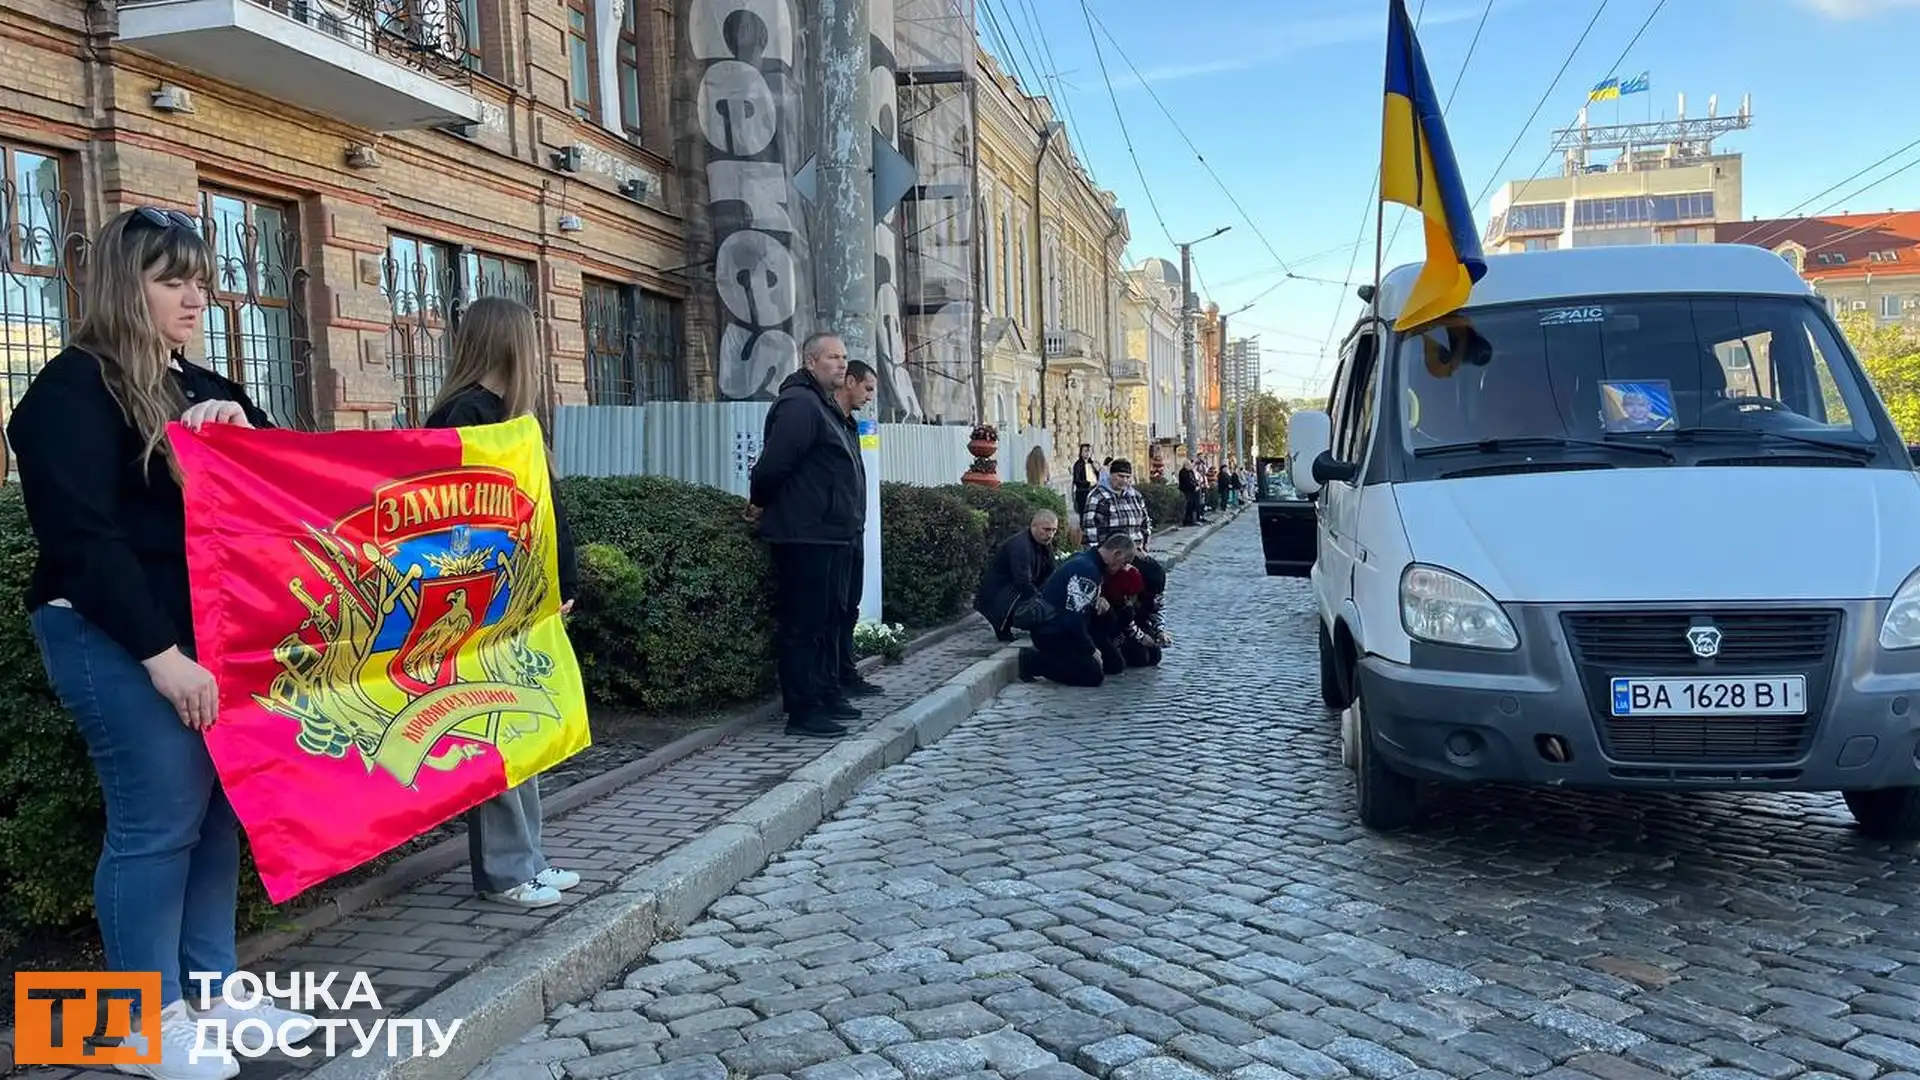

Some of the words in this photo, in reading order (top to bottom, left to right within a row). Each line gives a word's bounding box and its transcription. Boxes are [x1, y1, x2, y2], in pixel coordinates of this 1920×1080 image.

[380, 482, 514, 533] ЗАХИСНИК
[1632, 684, 1672, 709] BA
[1682, 683, 1746, 708] 1628
